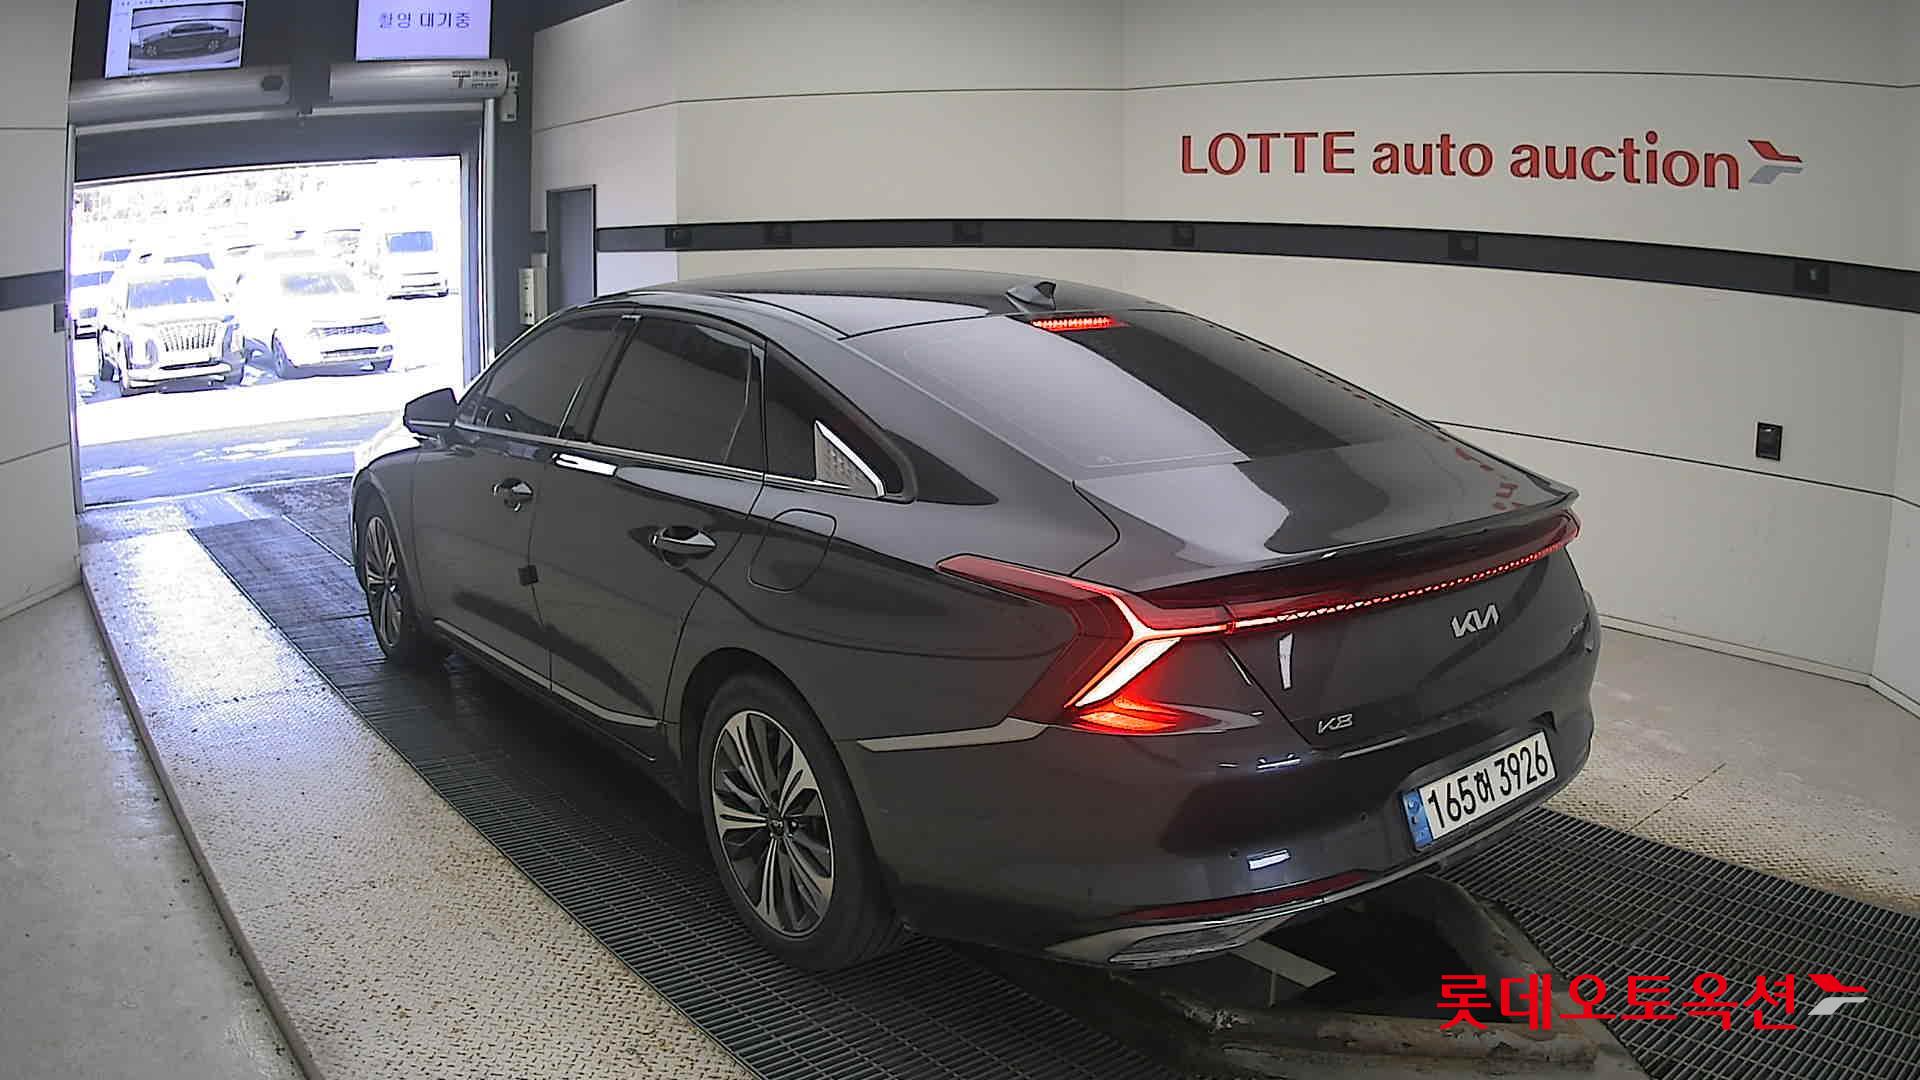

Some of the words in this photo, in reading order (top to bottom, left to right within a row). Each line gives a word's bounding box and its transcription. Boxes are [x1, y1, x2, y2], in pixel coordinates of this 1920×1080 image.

[420, 12, 472, 29] 대기중
[1181, 131, 1355, 175] LOTTE
[1371, 134, 1494, 176] auto
[1509, 130, 1740, 190] auction
[1451, 604, 1499, 638] KIA
[1317, 713, 1353, 734] K8
[1428, 769, 1495, 829] 165허
[1494, 740, 1548, 796] 3926
